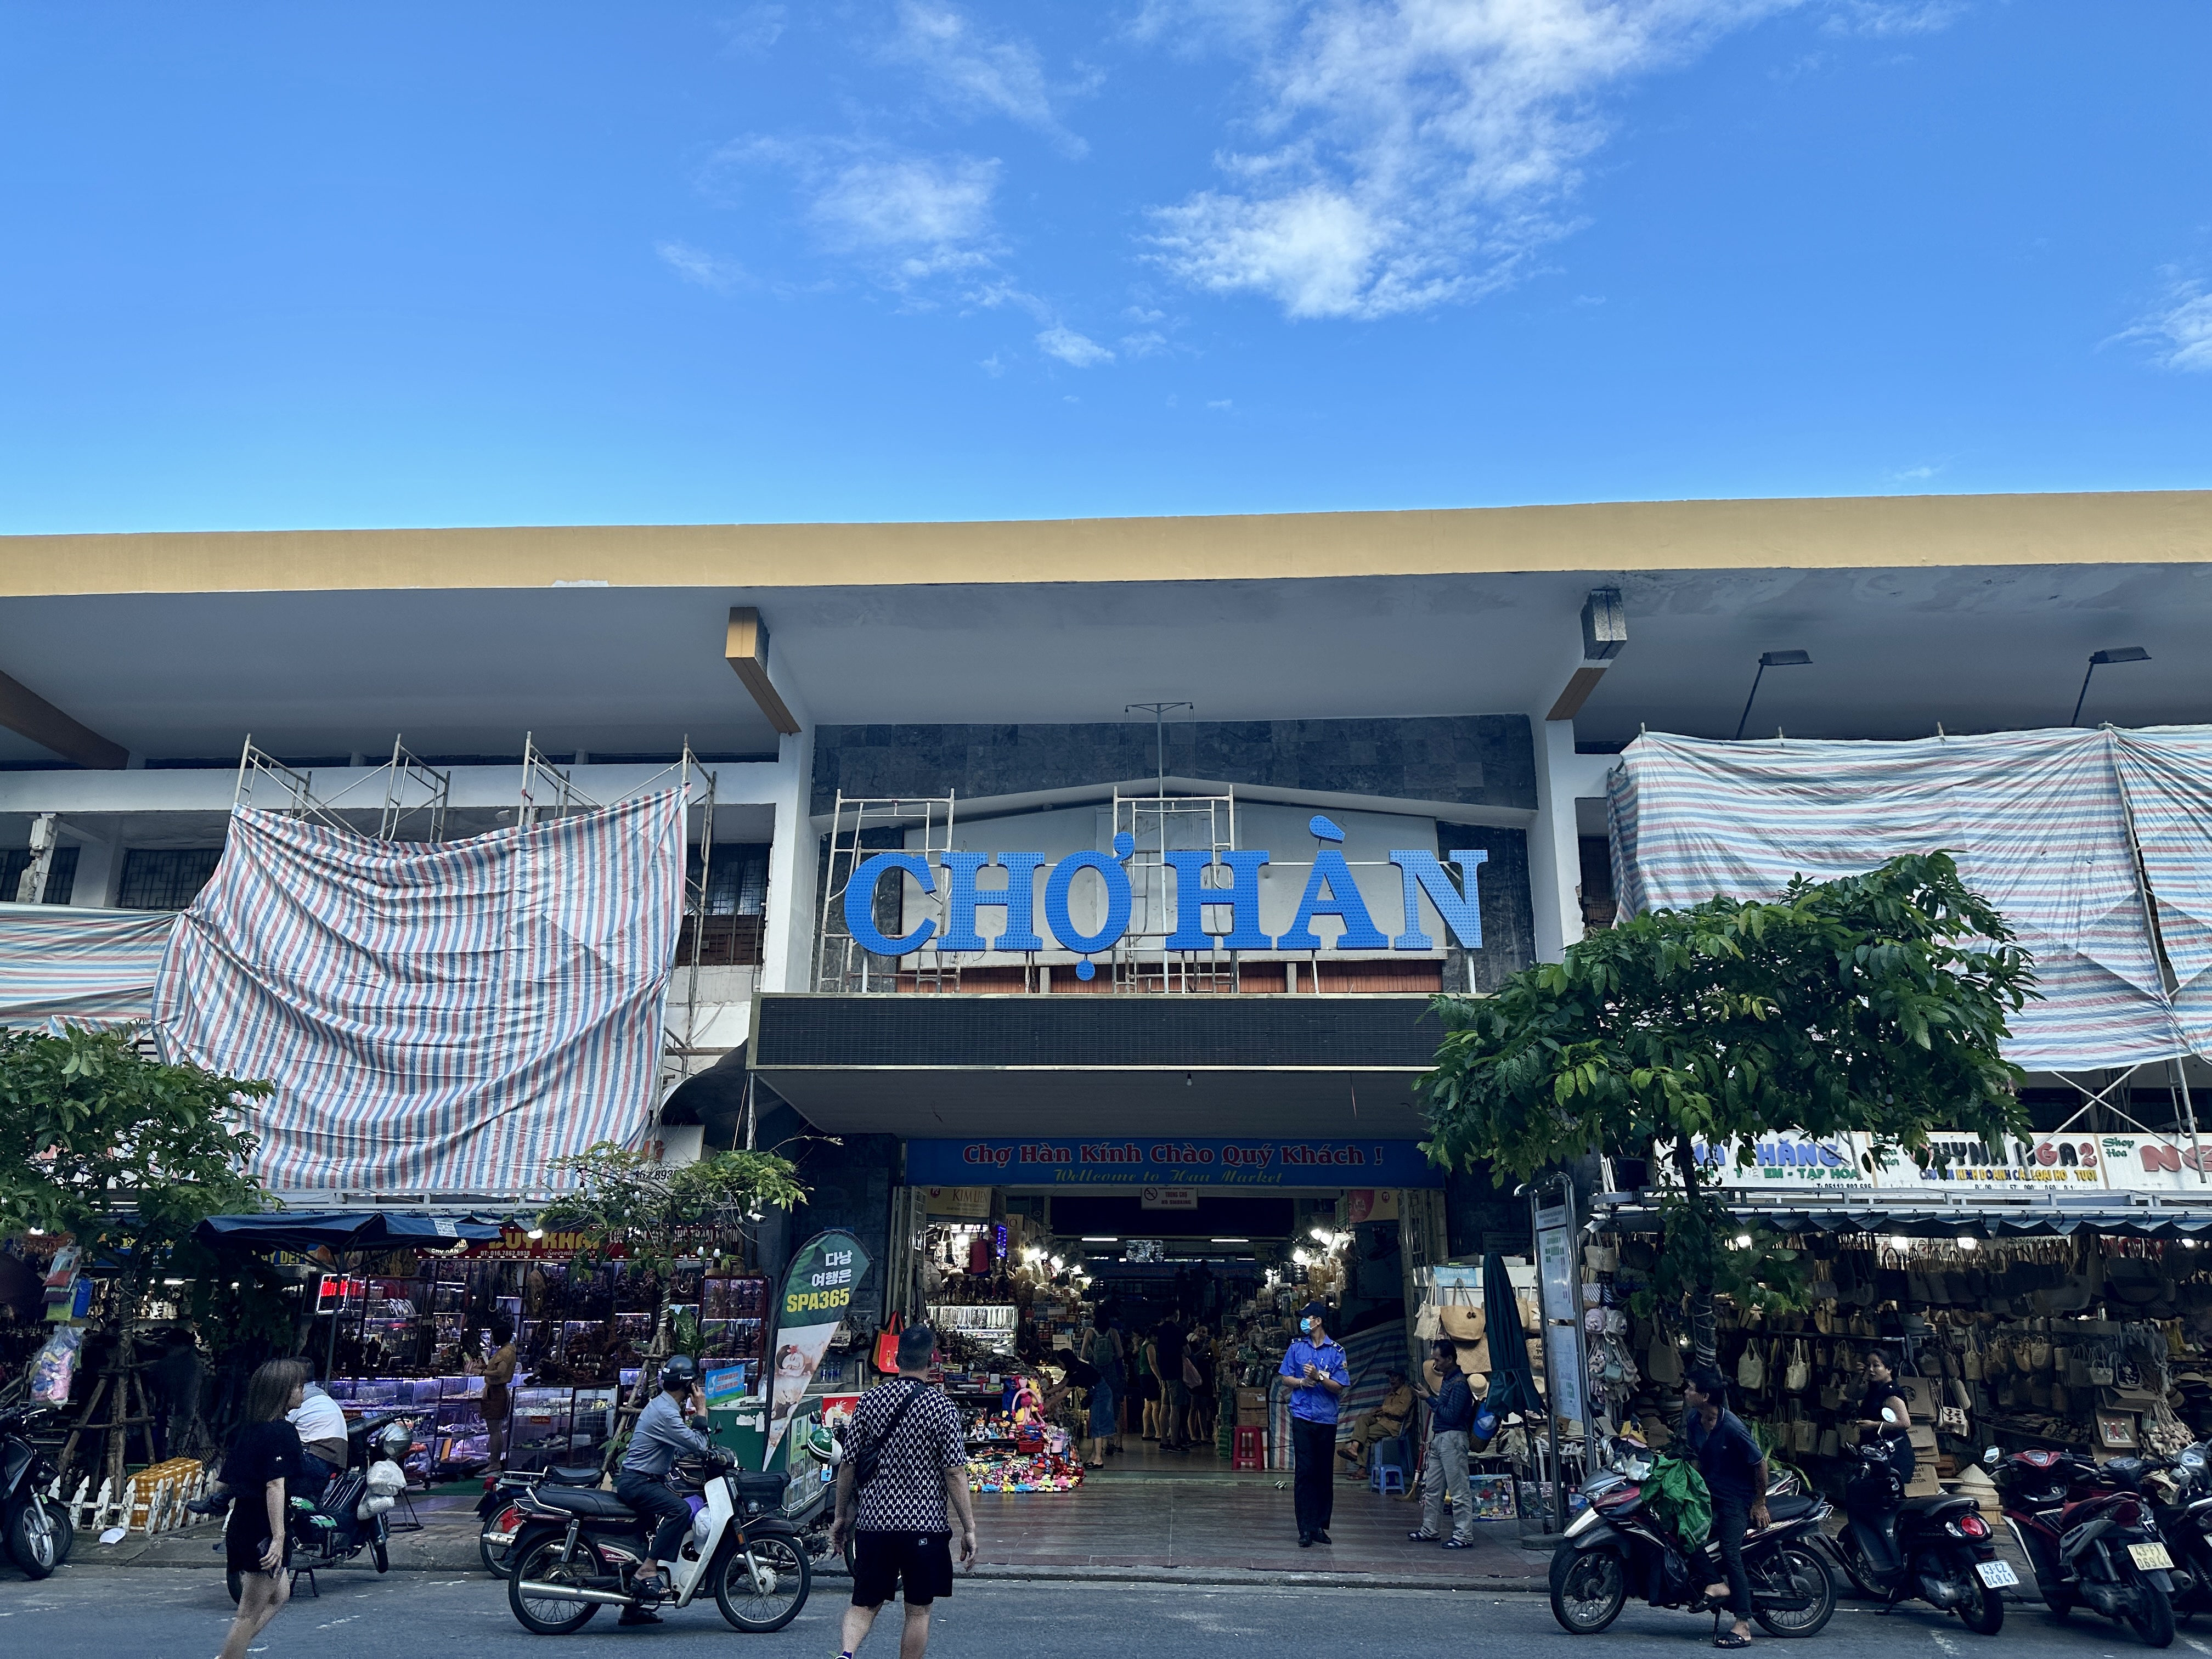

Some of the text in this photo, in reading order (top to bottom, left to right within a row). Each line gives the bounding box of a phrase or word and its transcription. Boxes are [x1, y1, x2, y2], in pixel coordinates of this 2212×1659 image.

[844, 815, 1488, 981] CHỢ HÀN
[2102, 1137, 2134, 1149] Shop
[963, 1143, 1014, 1168] Chợ
[1019, 1142, 1073, 1164] Hàn
[1079, 1142, 1143, 1164] Kính
[1150, 1142, 1215, 1164] Chào
[1221, 1143, 1276, 1169] Quý
[1280, 1143, 1365, 1165] Khách
[2106, 1148, 2128, 1158] Hoa
[1053, 1169, 1136, 1182] Wellcome
[1143, 1171, 1159, 1182] to
[1221, 1169, 1283, 1183] Market
[952, 1189, 972, 1202] KIM
[825, 1250, 853, 1267] 다낭
[811, 1268, 852, 1286] 여행은
[786, 1287, 850, 1312] SPA365
[1982, 1563, 2007, 1575] 43-C2
[1984, 1572, 2015, 1586] 048.41
